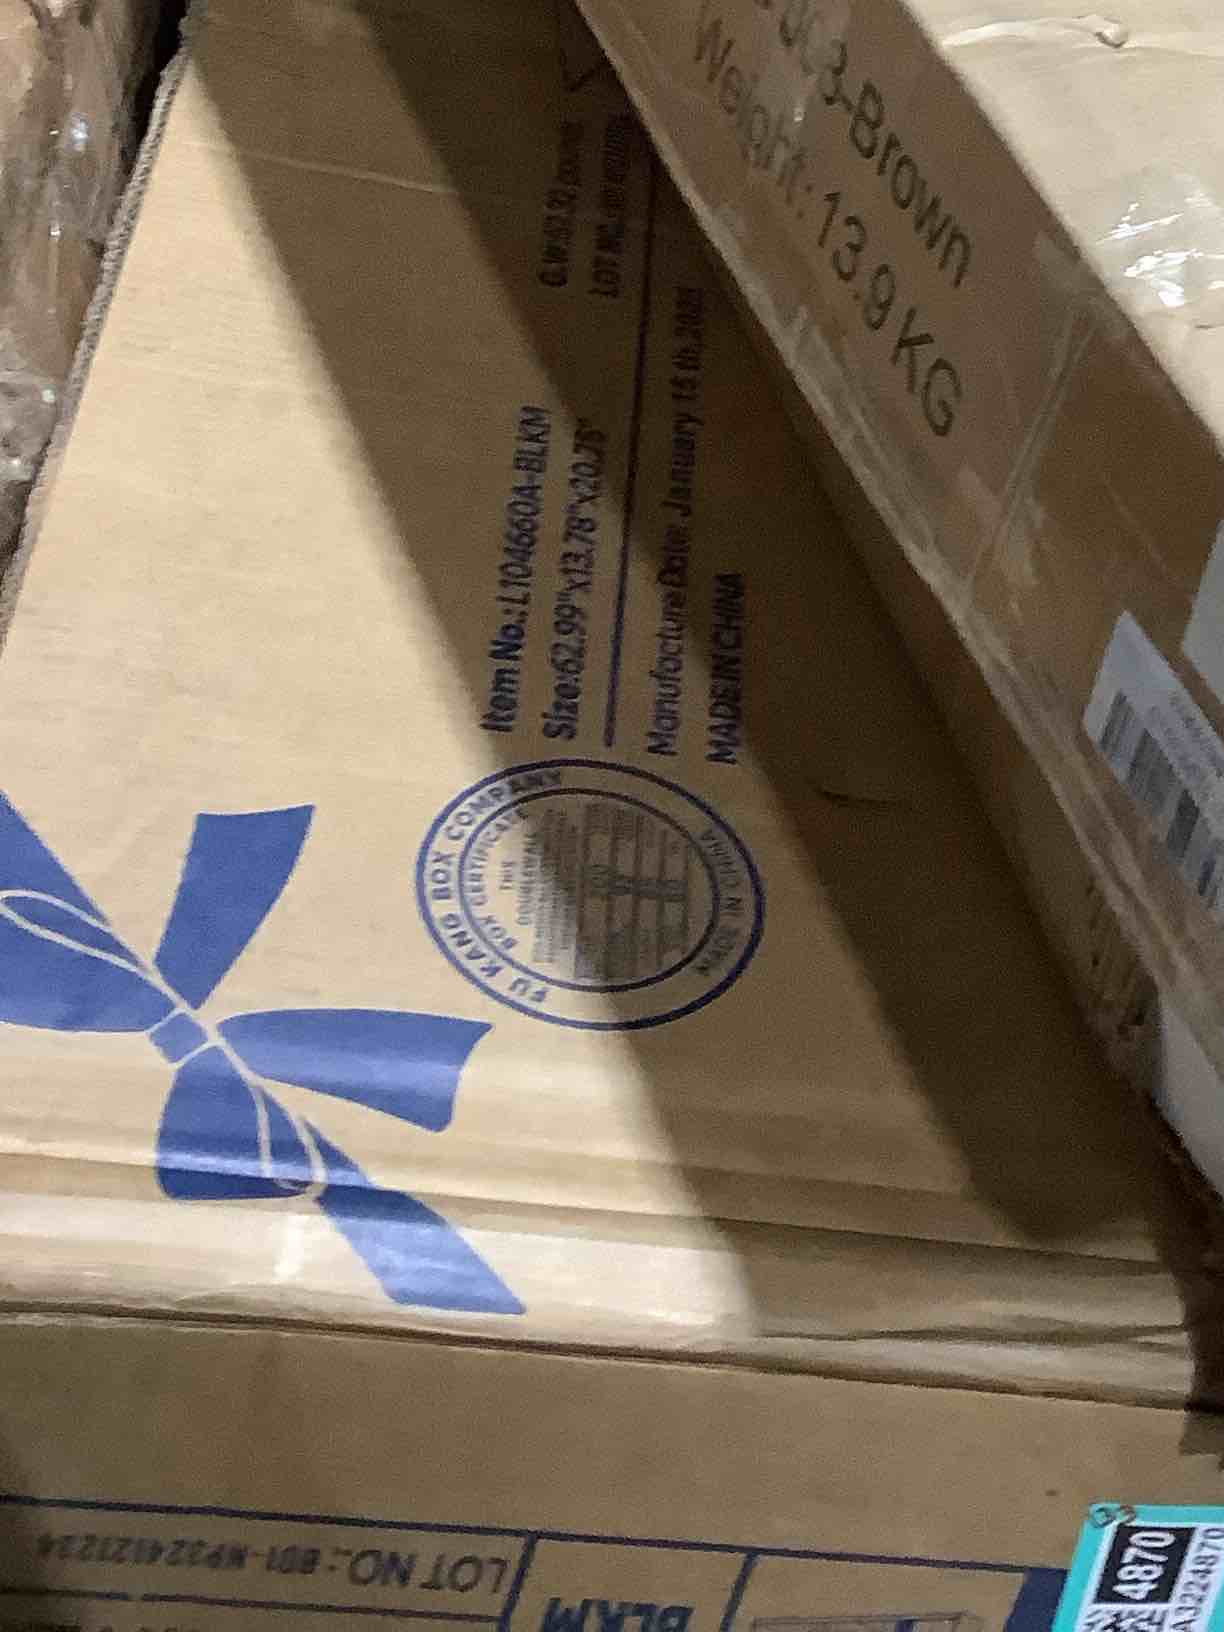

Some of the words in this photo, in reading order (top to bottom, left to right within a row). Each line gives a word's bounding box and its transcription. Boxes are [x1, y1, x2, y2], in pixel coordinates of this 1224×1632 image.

[890, 306, 965, 439] KG
[480, 665, 522, 734] Item
[431, 850, 455, 901] BOX
[423, 1552, 510, 1595] LOT
[1112, 1530, 1177, 1601] 4870
